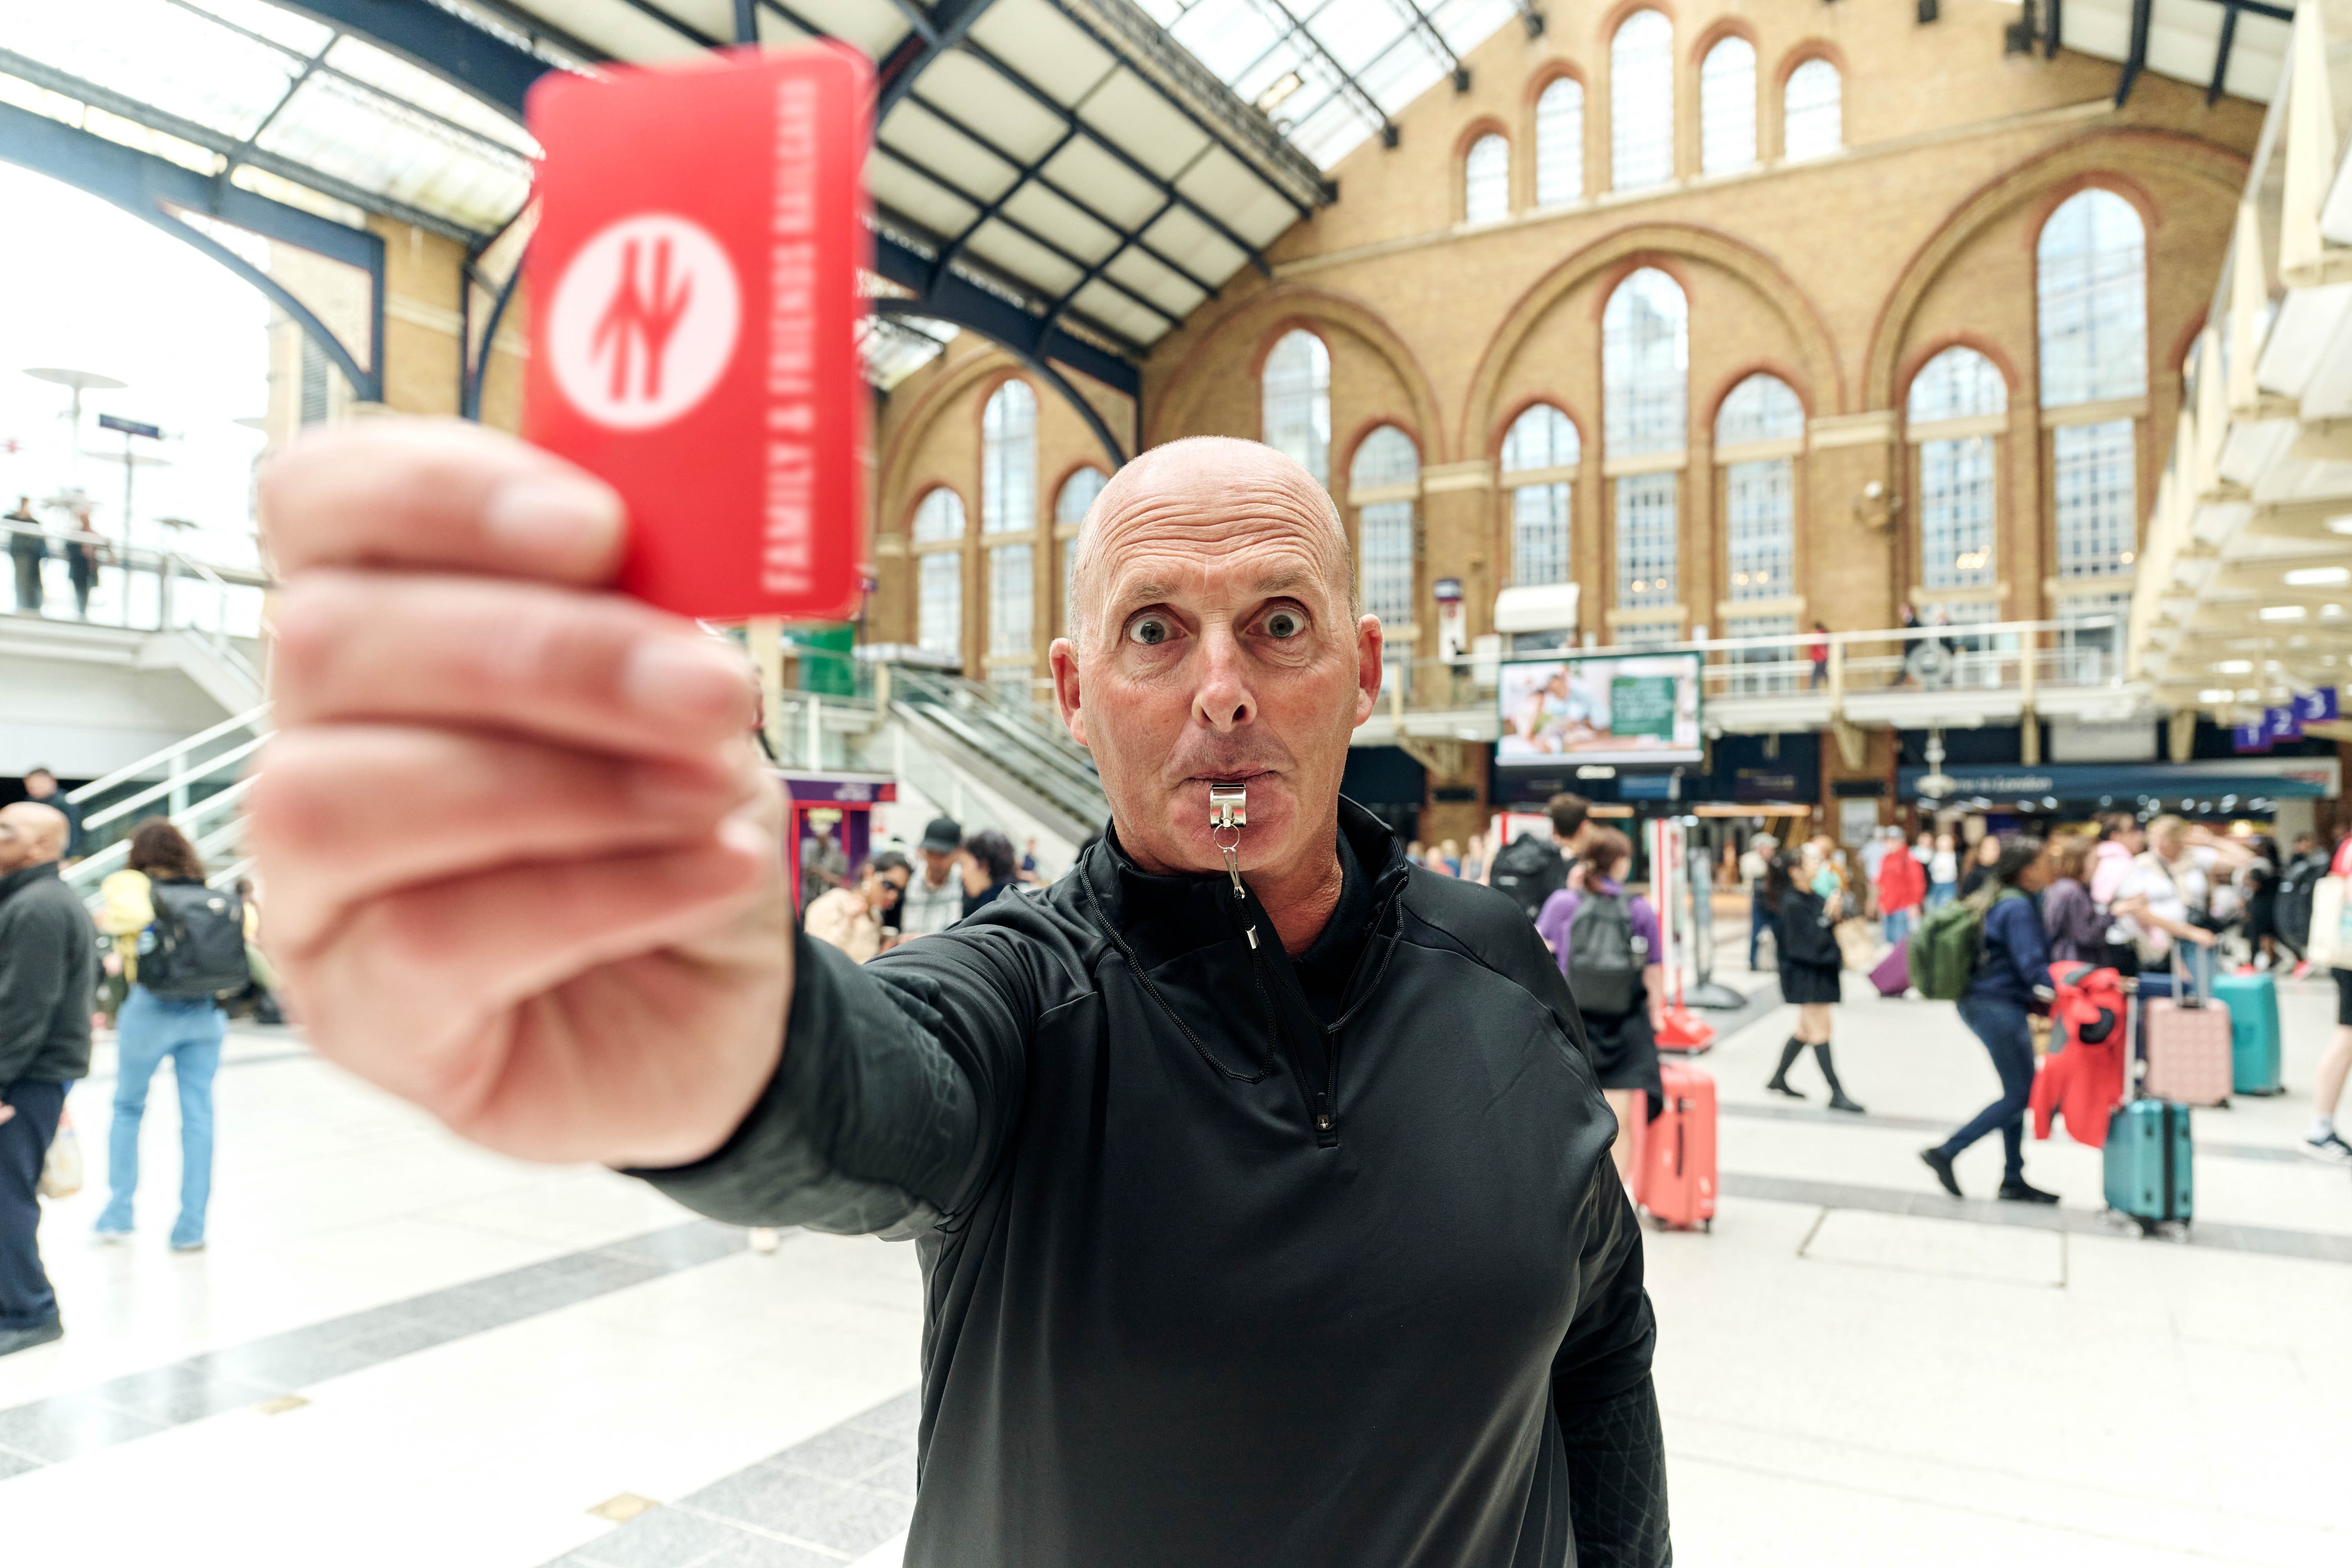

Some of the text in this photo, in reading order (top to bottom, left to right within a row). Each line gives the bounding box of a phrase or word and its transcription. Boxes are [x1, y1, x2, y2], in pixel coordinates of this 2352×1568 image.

[763, 79, 817, 593] FAMILY & FRIENDS RAILCARD
[2305, 690, 2327, 719] 3
[2273, 708, 2293, 735] 2
